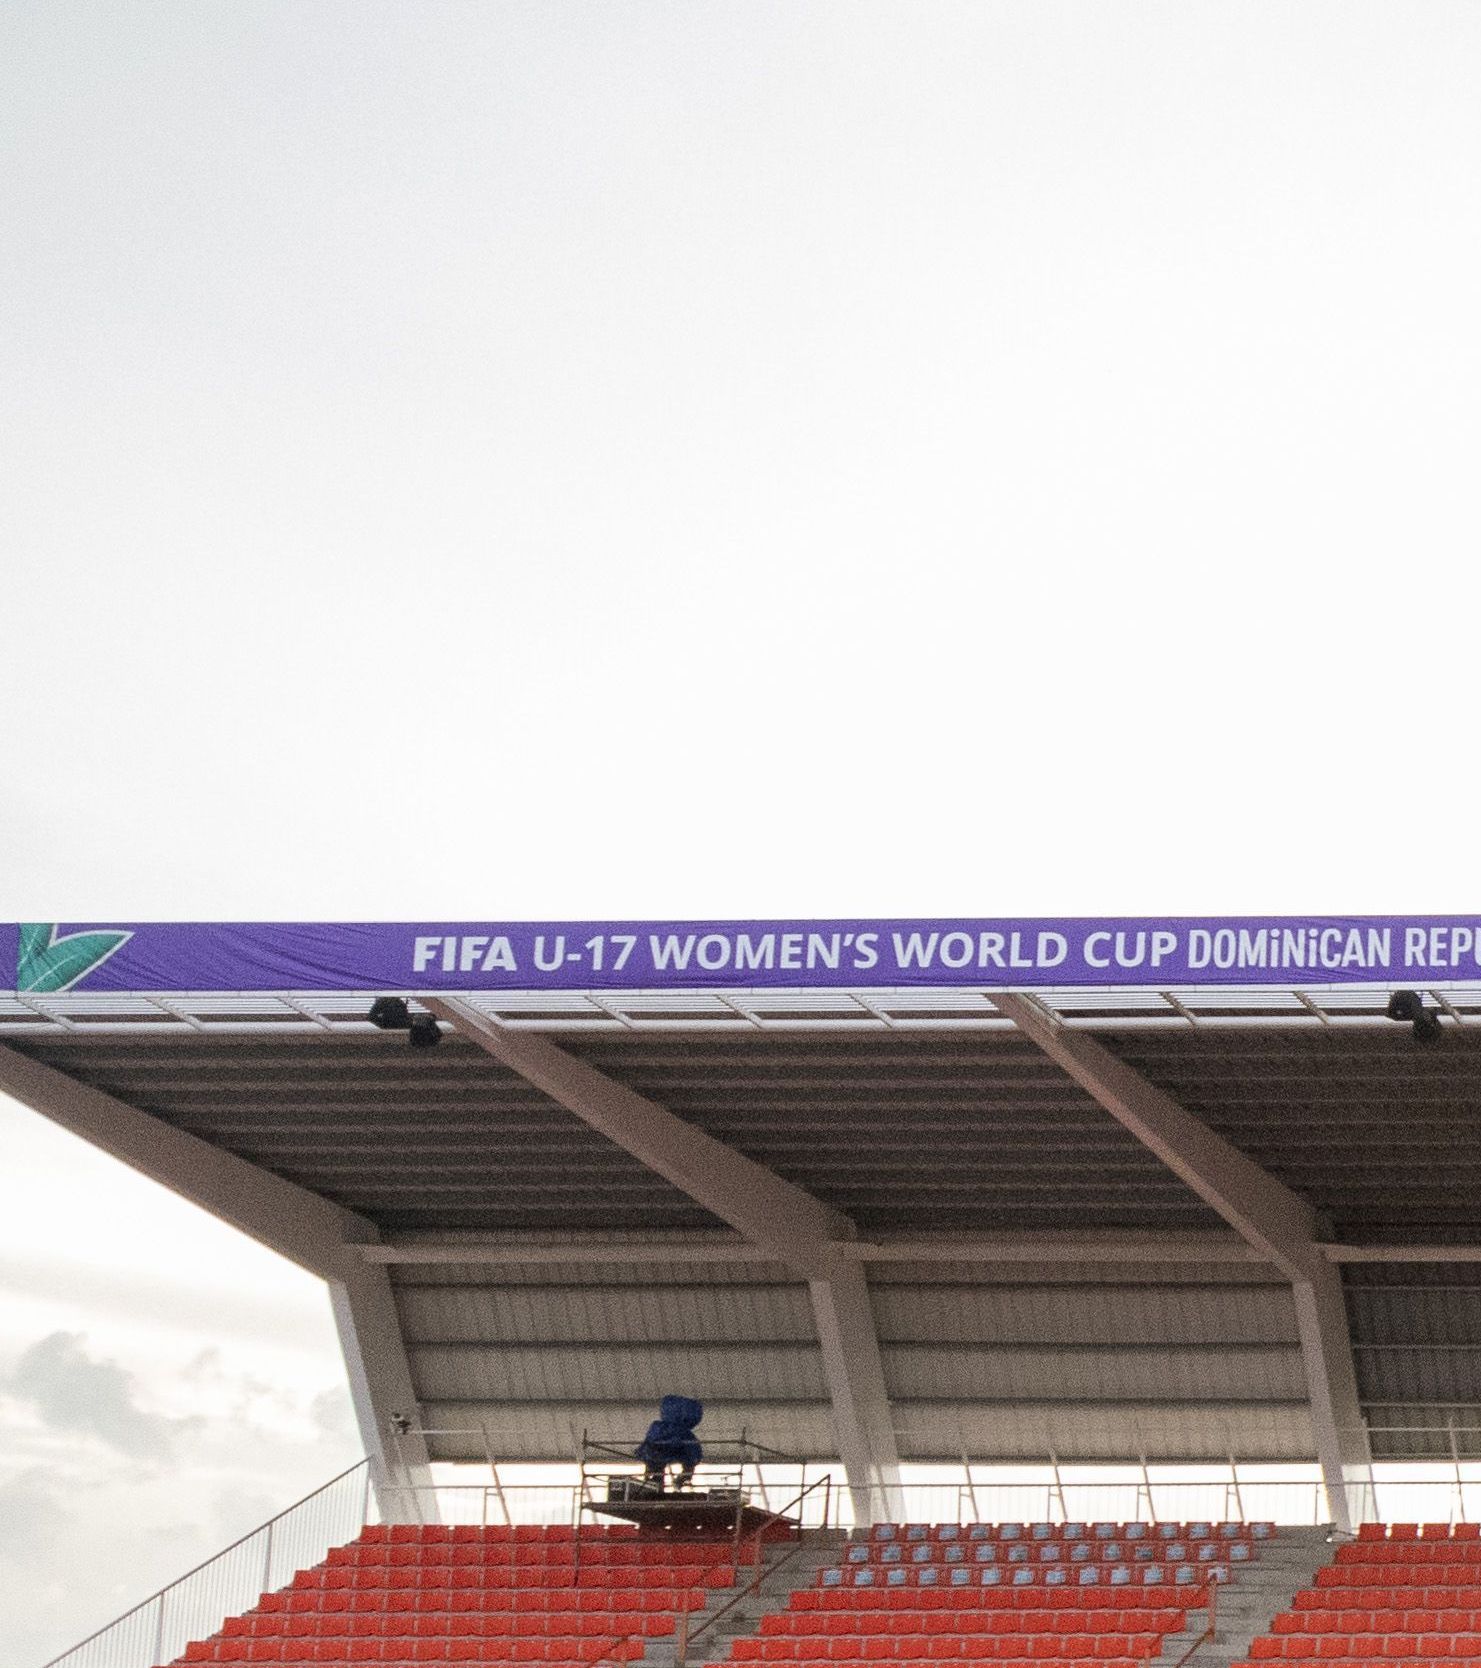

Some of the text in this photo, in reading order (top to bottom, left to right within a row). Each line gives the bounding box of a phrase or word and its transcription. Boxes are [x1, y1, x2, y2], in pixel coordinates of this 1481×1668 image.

[413, 936, 517, 972] FIFA
[532, 934, 637, 972] U-17
[649, 933, 879, 970] WOMEN’S
[893, 931, 1068, 969] WORLD
[1082, 931, 1178, 968] CUP
